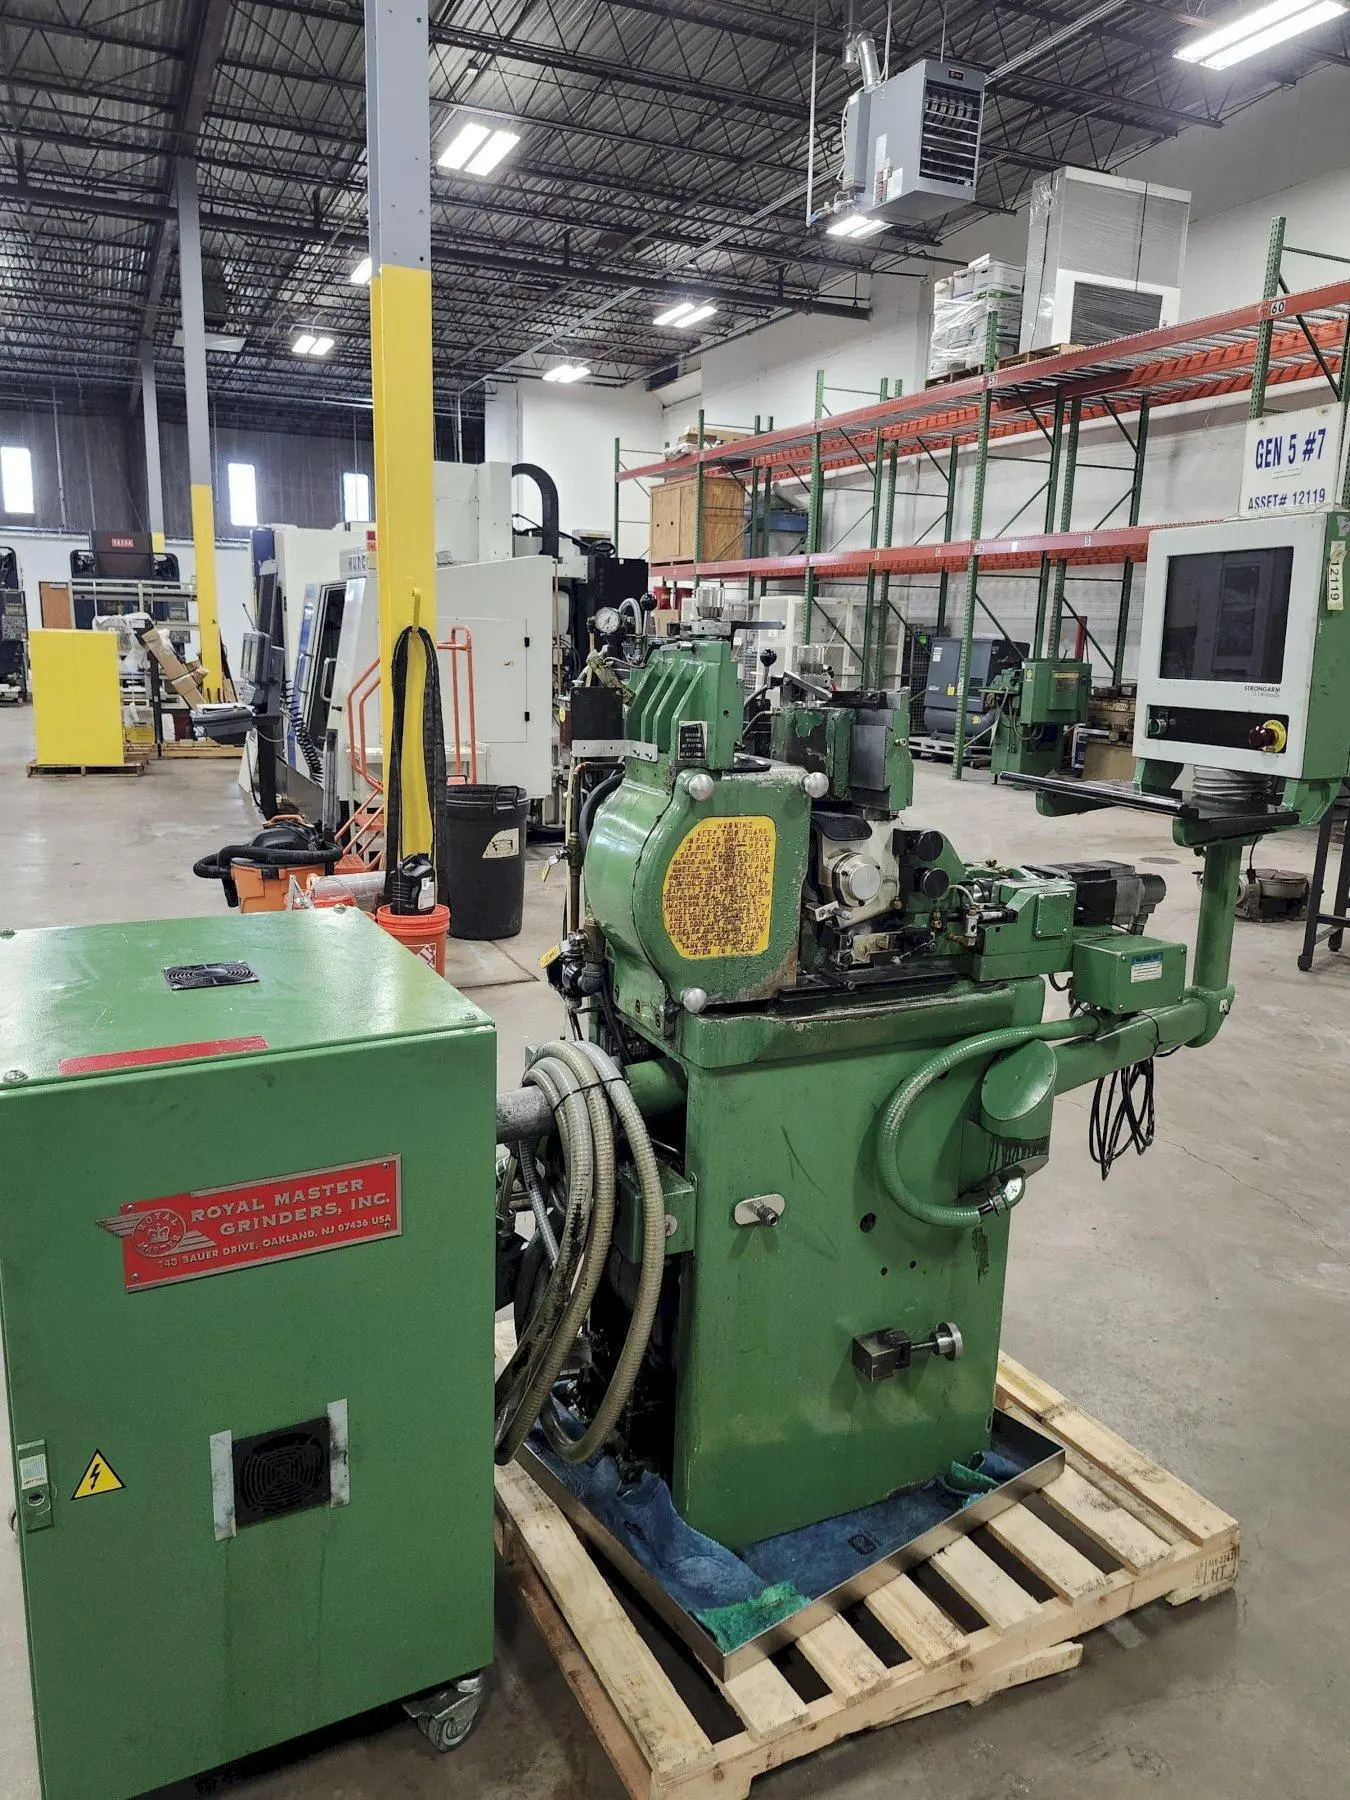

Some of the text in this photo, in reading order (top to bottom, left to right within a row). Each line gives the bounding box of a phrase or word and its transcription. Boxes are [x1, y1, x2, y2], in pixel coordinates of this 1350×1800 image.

[1272, 302, 1284, 314] 60
[1256, 428, 1326, 470] GEN 5 #7
[1293, 488, 1326, 506] 12119
[1330, 560, 1340, 600] 12119
[191, 1178, 365, 1222] ROYAL MASTER
[220, 1192, 391, 1236] GRINDERS, INC.
[136, 1212, 181, 1232] ROYAL
[182, 1250, 219, 1264] BAUER
[222, 1242, 259, 1256] DRIVE,
[262, 1229, 318, 1247] OAKLAND,
[321, 1227, 335, 1236] NJ
[338, 1220, 369, 1232] 07436
[372, 1214, 392, 1225] USA
